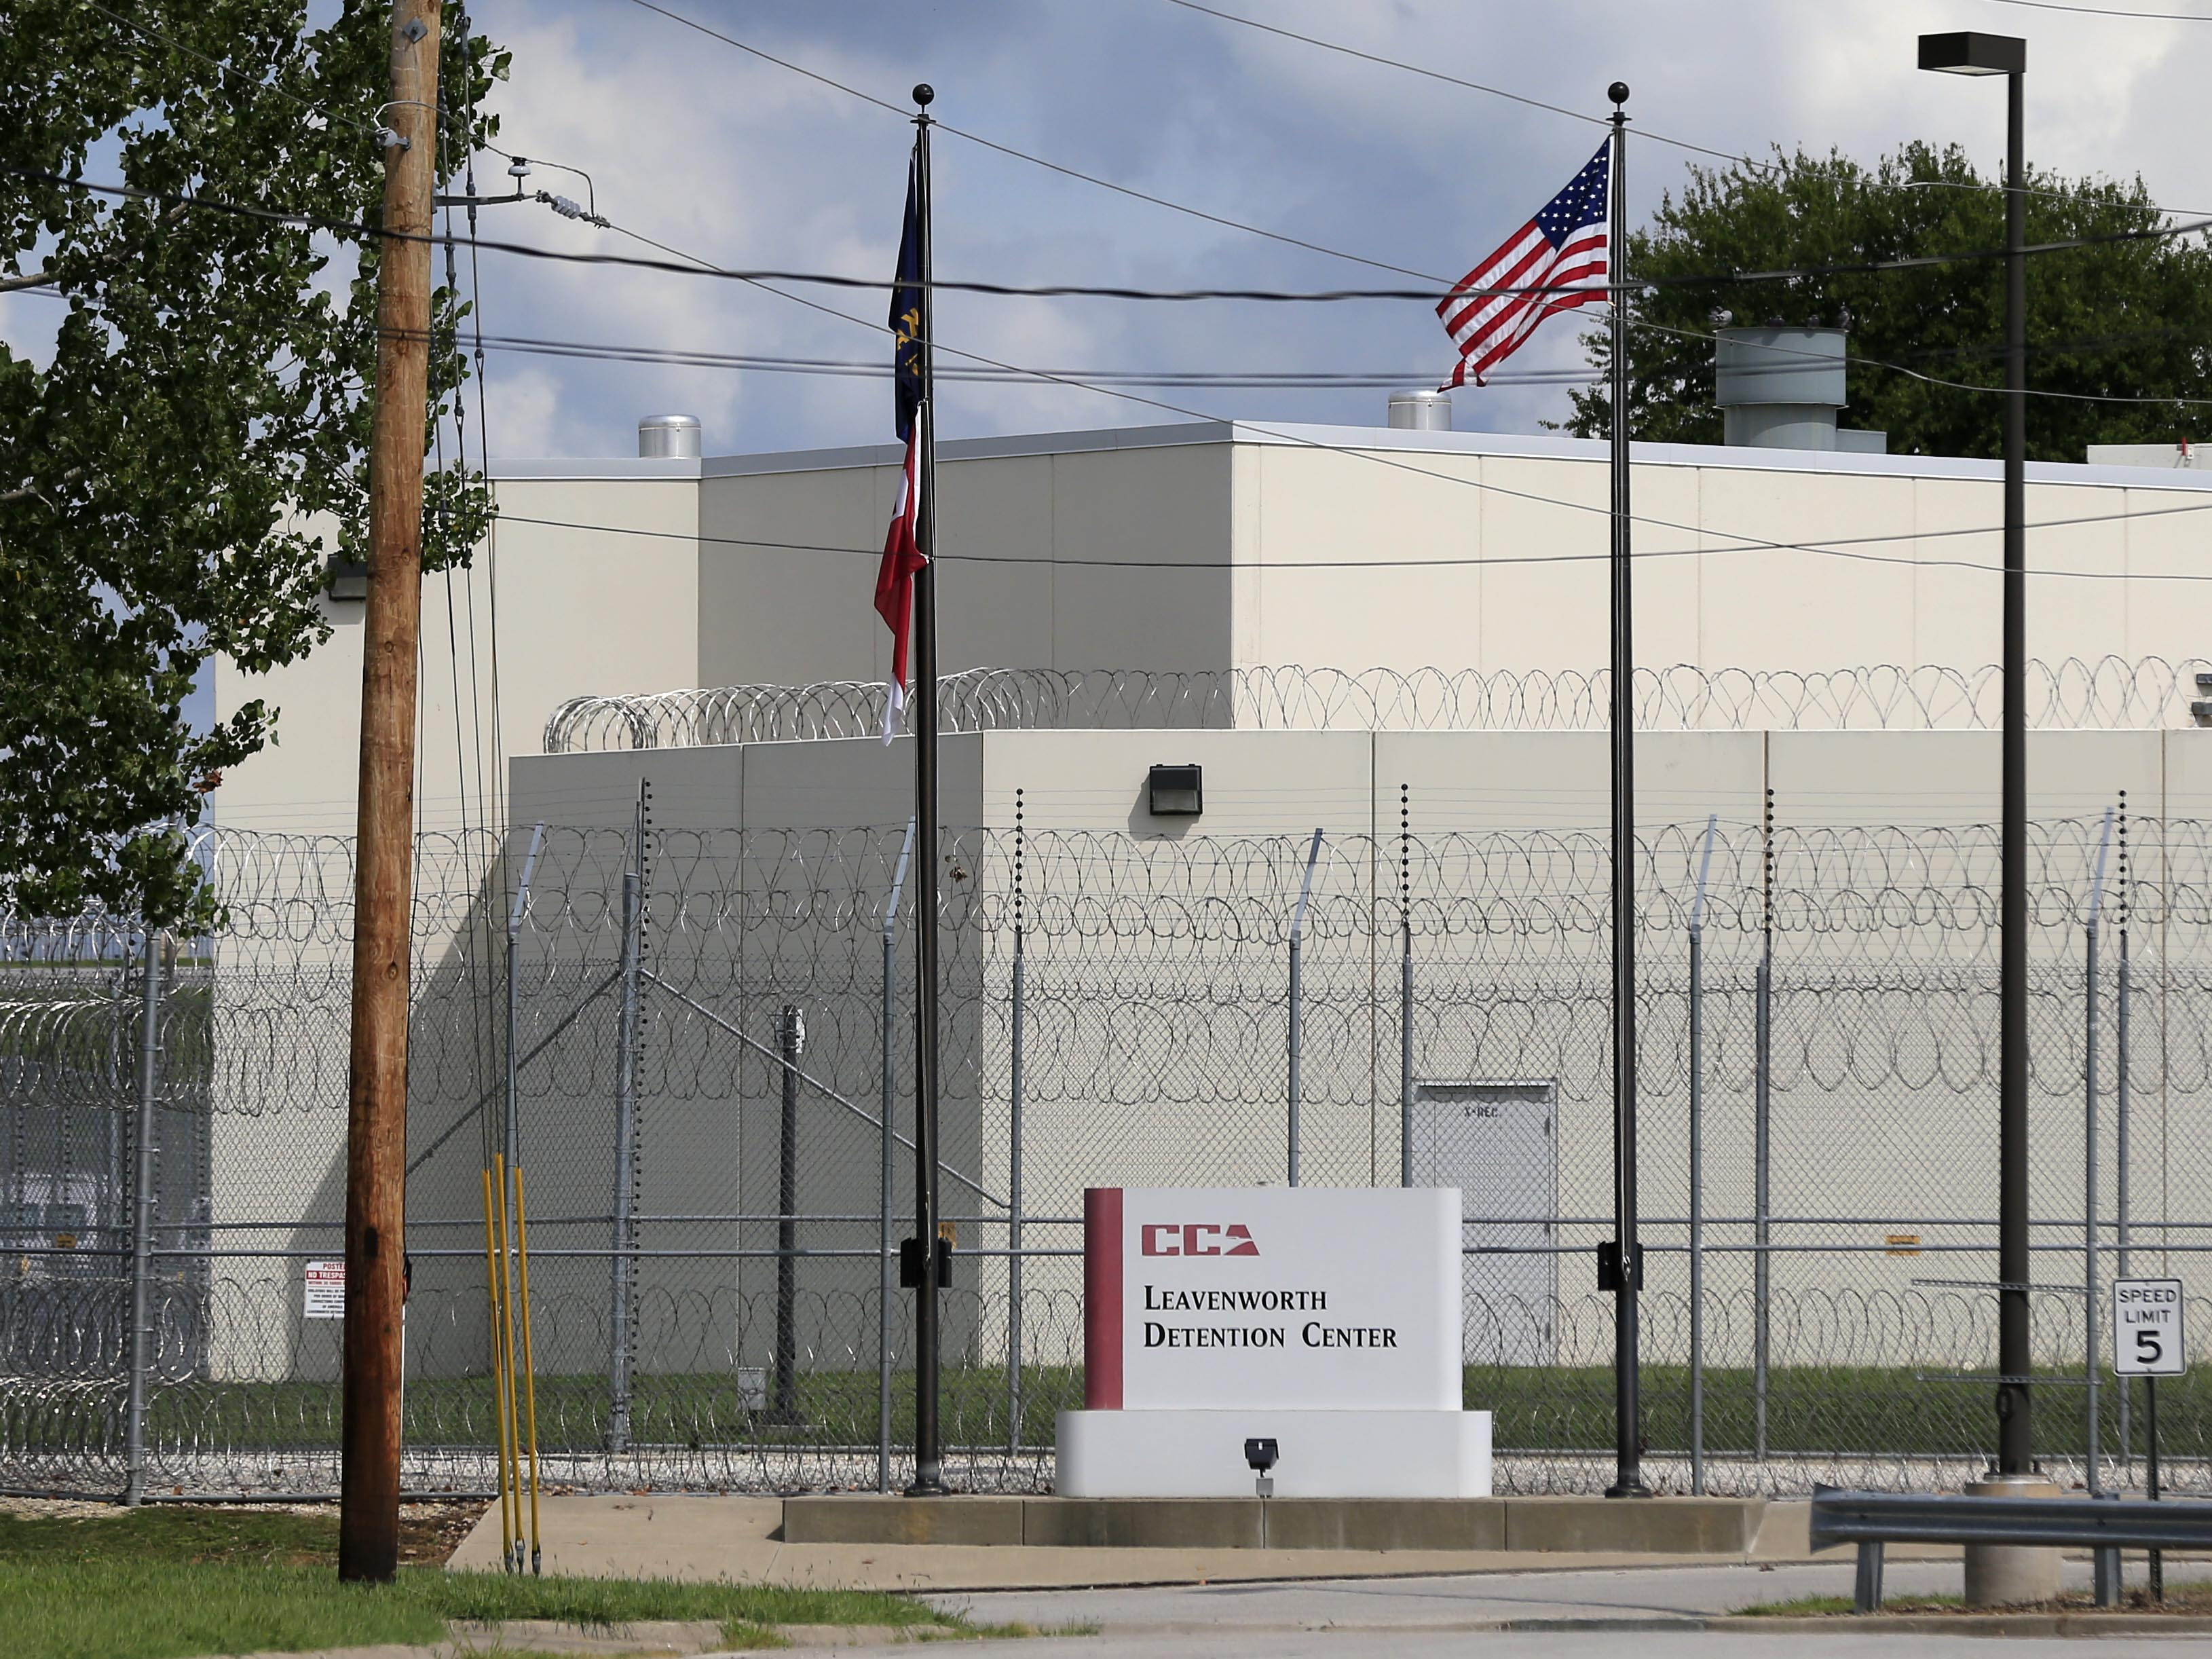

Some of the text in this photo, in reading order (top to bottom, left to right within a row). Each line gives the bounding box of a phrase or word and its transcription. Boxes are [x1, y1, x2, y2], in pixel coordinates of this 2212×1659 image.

[1142, 1225, 1260, 1256] CCA
[307, 1271, 318, 1279] NO
[1144, 1285, 1328, 1311] LEAVENWORTH
[2119, 1290, 2177, 1303] SPEED
[2125, 1310, 2171, 1323] LIMIT
[1144, 1322, 1398, 1347] DETENTION CENTER
[2136, 1330, 2164, 1364] 5
